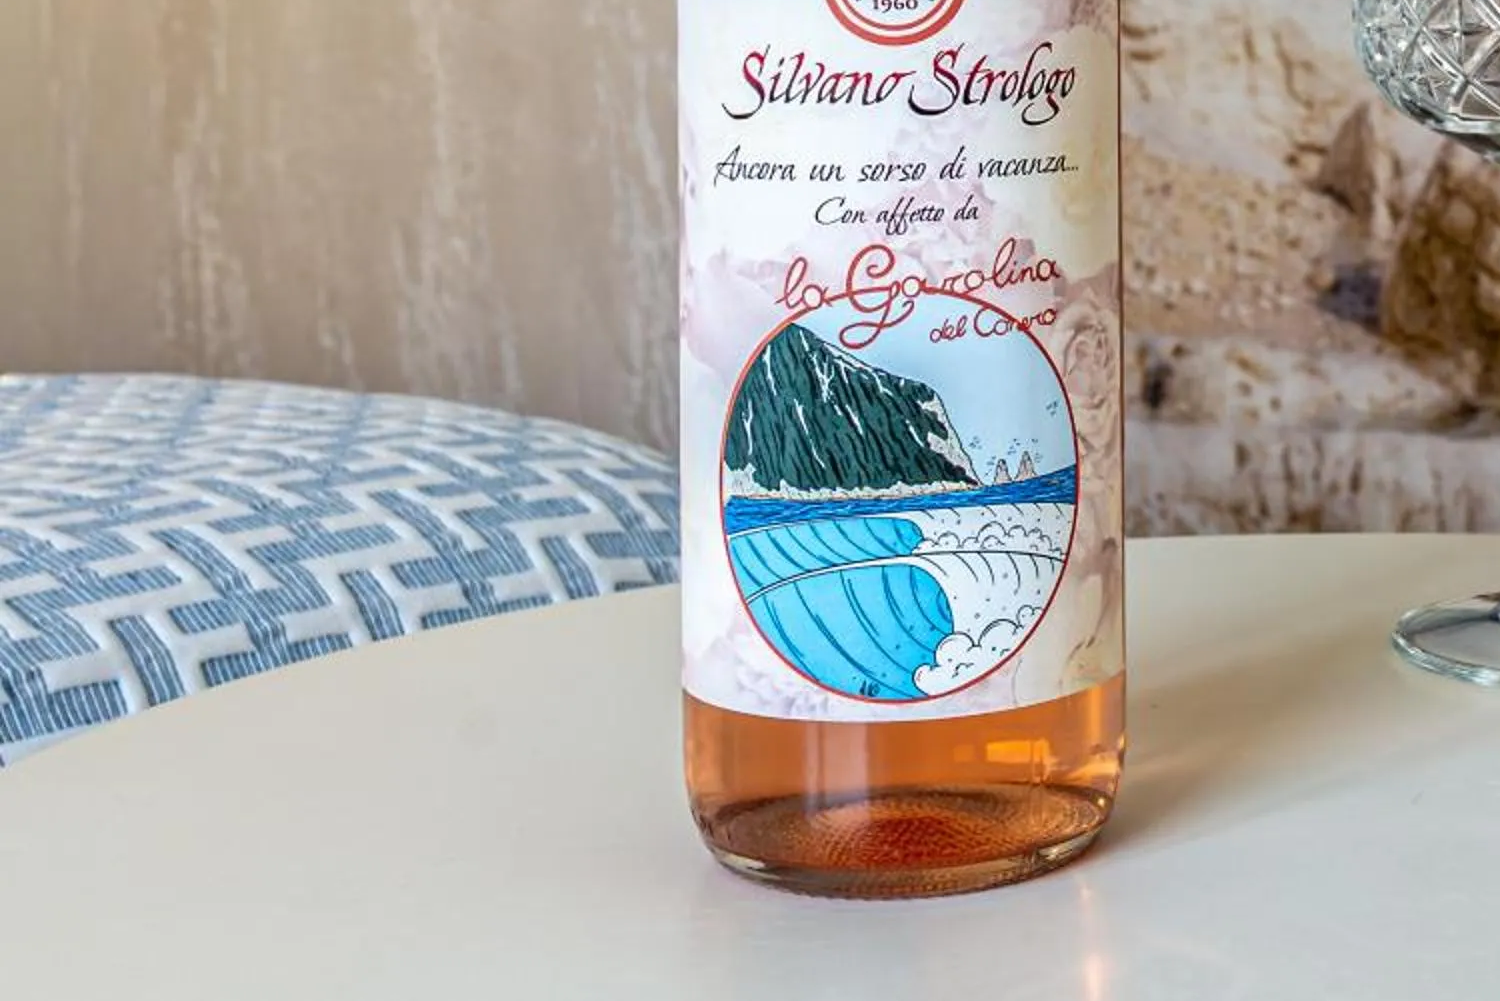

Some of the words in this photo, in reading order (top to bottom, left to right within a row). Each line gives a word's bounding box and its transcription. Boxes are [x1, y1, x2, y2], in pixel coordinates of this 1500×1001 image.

[721, 43, 916, 120] Silvano
[908, 42, 1076, 126] Strologo
[714, 144, 797, 187] Ancora
[809, 160, 846, 182] un
[857, 158, 926, 182] sorso
[939, 145, 967, 180] di
[976, 152, 1080, 178] vacanza...
[814, 196, 868, 226] Con
[876, 196, 946, 236] affetto
[953, 195, 980, 221] da
[775, 257, 833, 310] la
[929, 314, 968, 343] del
